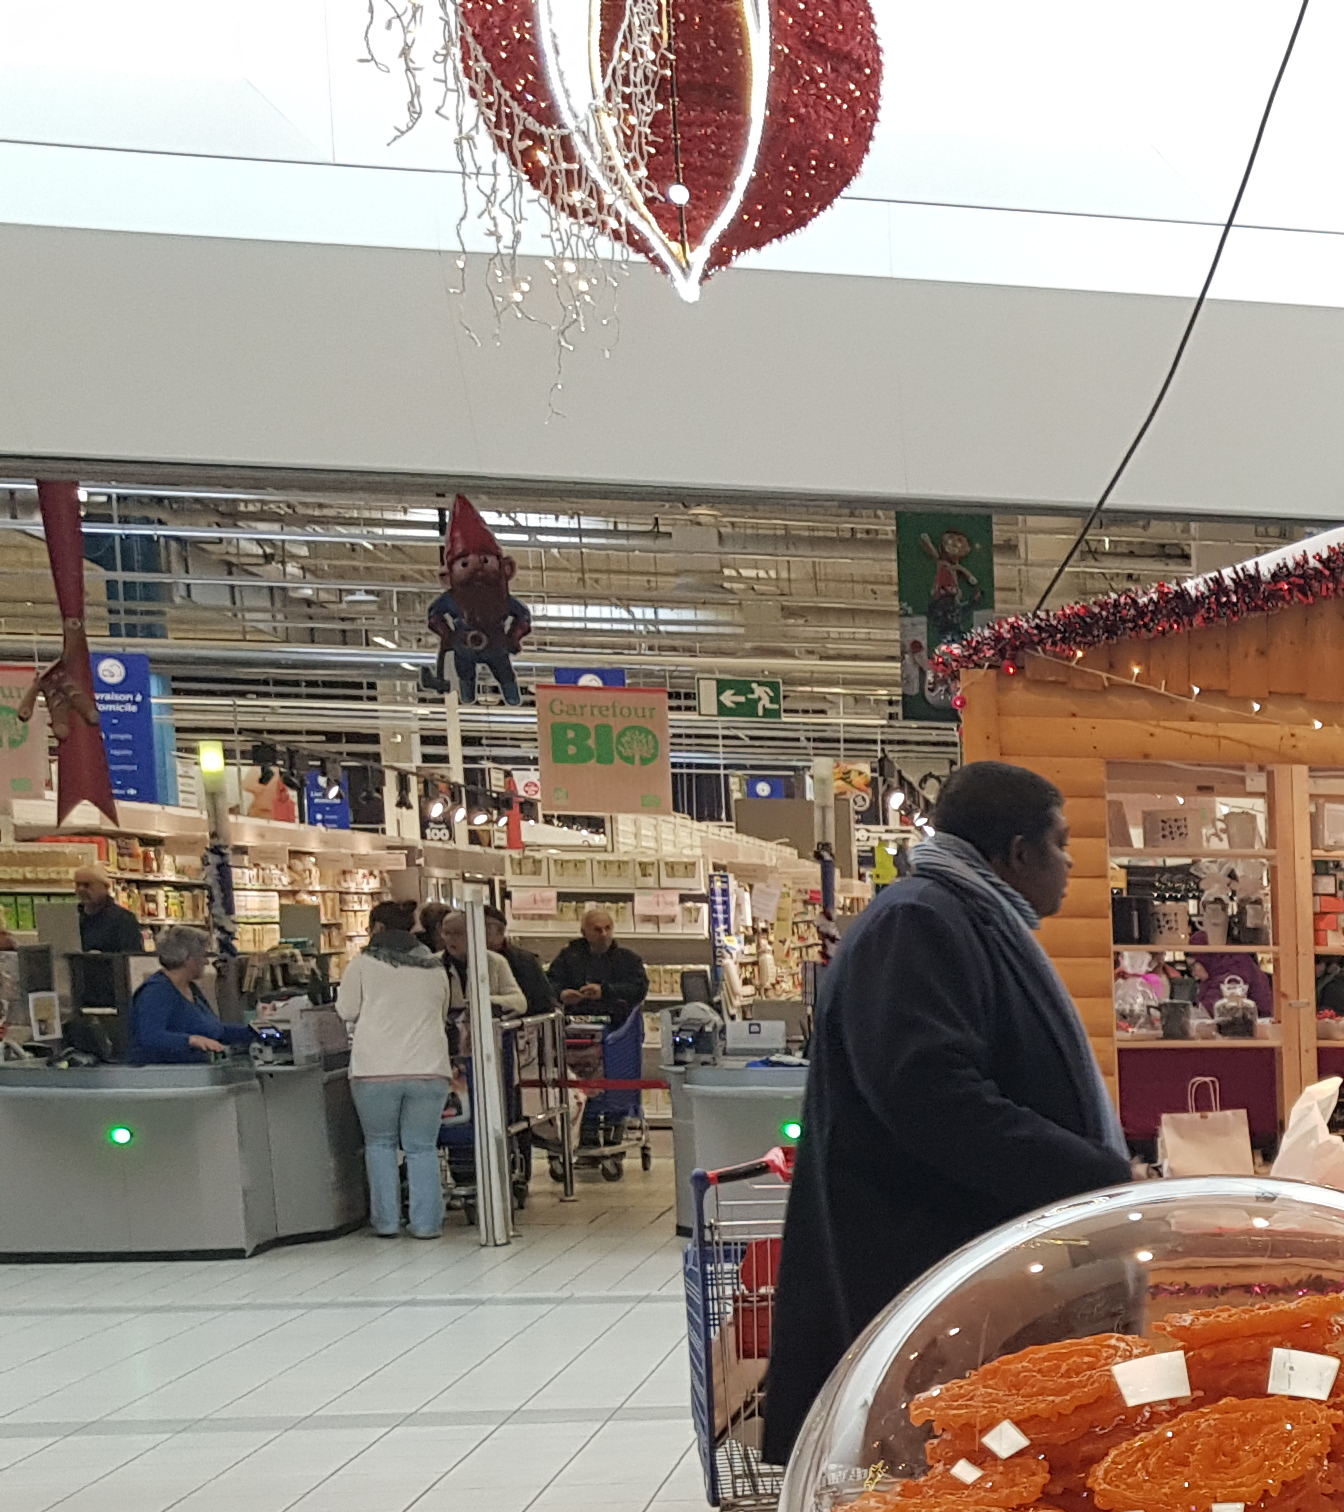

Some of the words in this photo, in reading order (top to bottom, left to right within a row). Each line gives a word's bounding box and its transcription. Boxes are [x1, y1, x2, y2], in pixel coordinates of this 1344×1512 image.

[548, 698, 656, 720] Carrefour
[550, 721, 660, 767] BIO
[424, 827, 450, 841] 100
